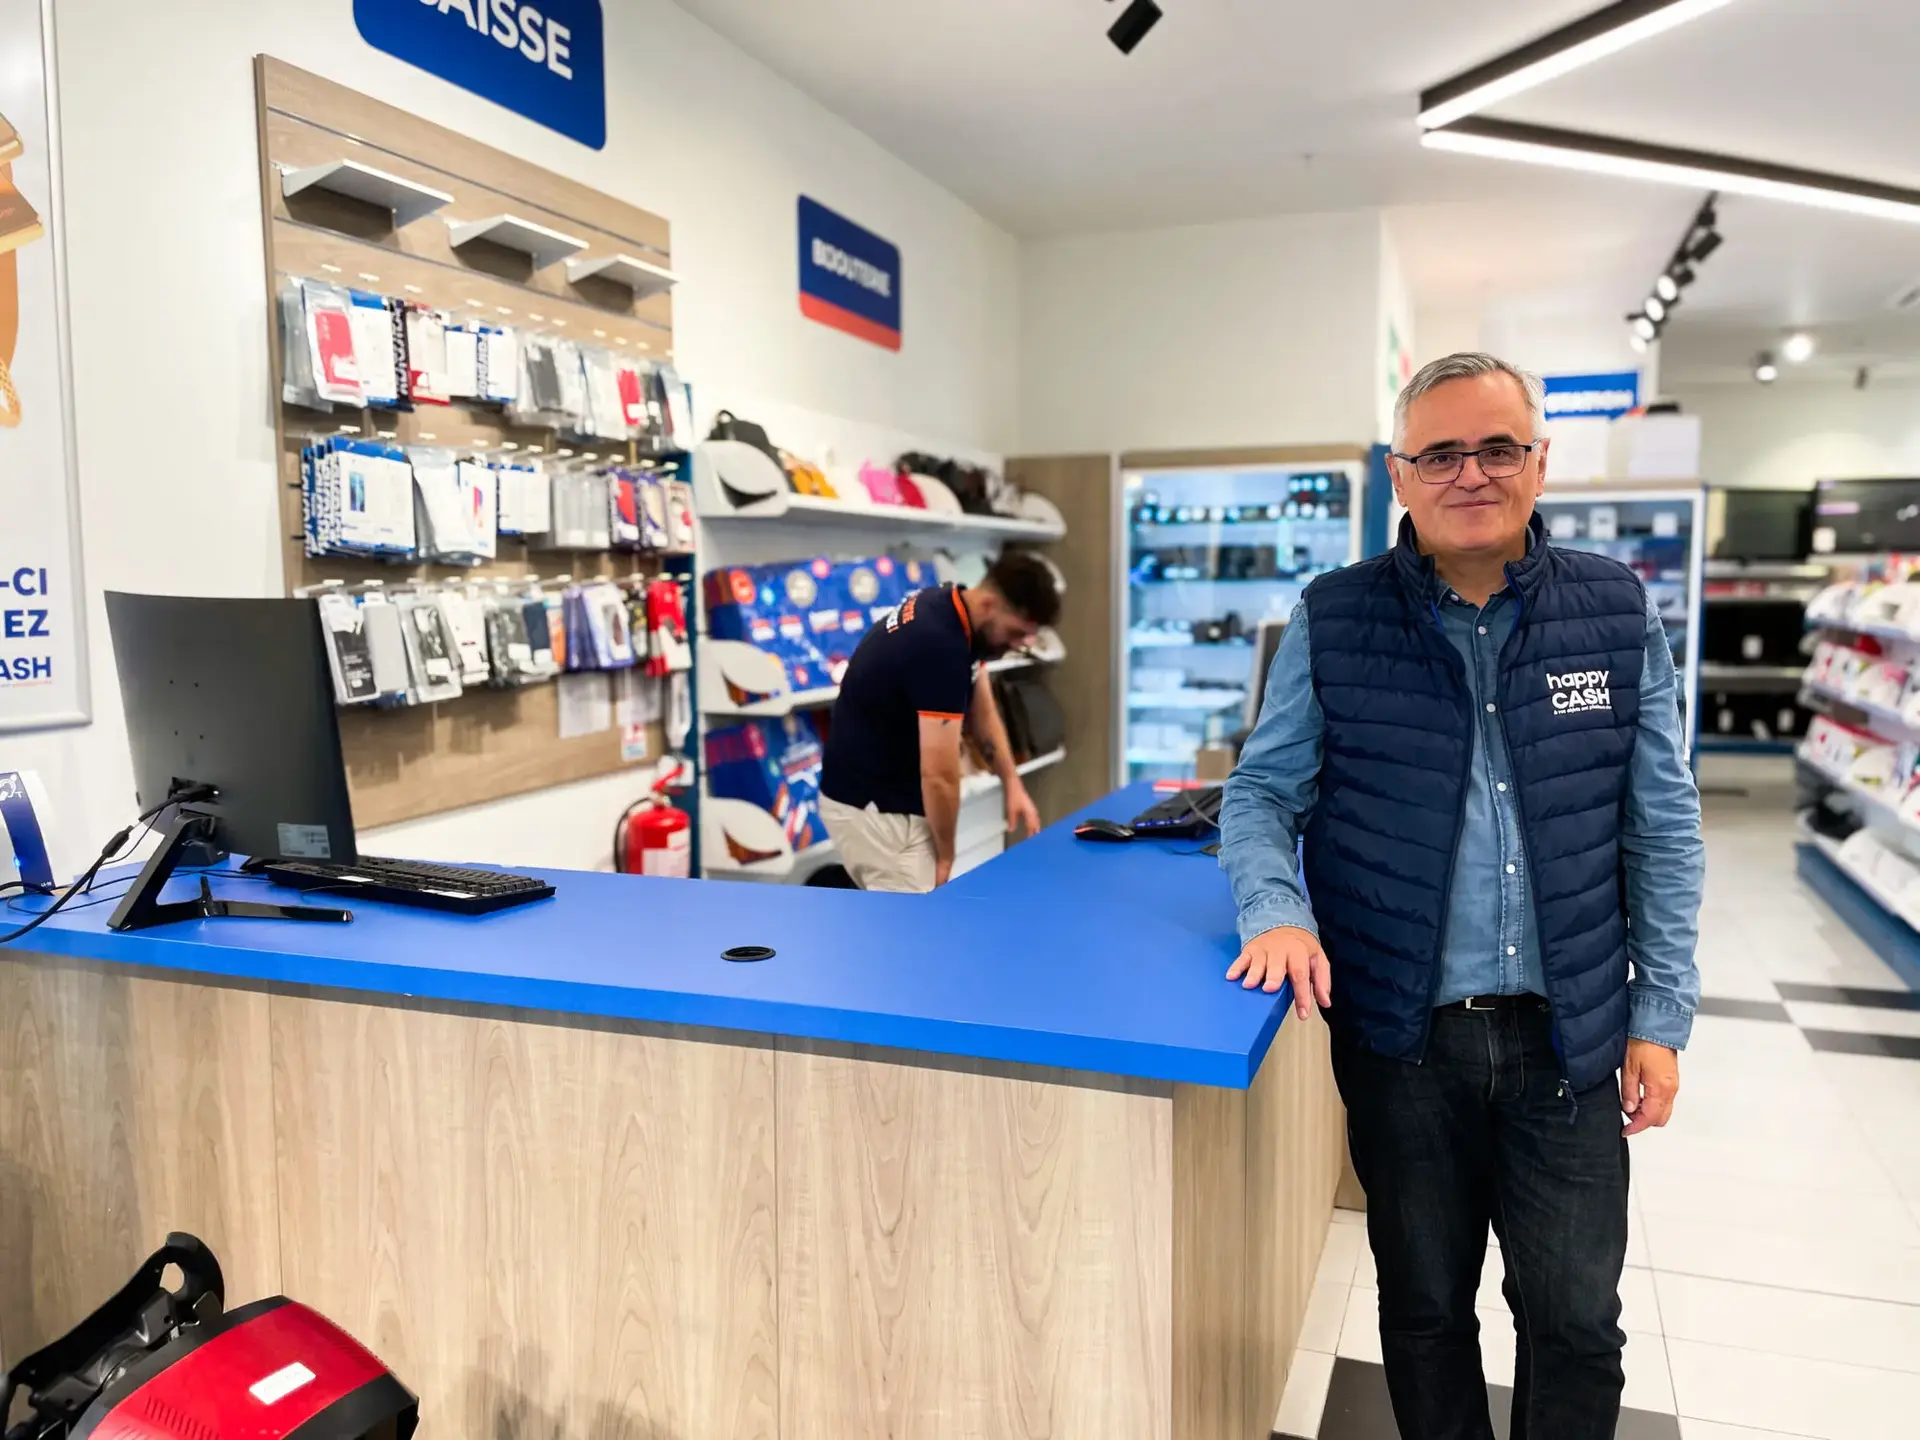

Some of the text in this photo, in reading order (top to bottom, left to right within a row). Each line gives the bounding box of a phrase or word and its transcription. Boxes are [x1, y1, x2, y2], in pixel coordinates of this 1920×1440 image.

[420, 0, 573, 80] AISSE
[1546, 670, 1609, 689] happy
[1552, 688, 1610, 709] CASH
